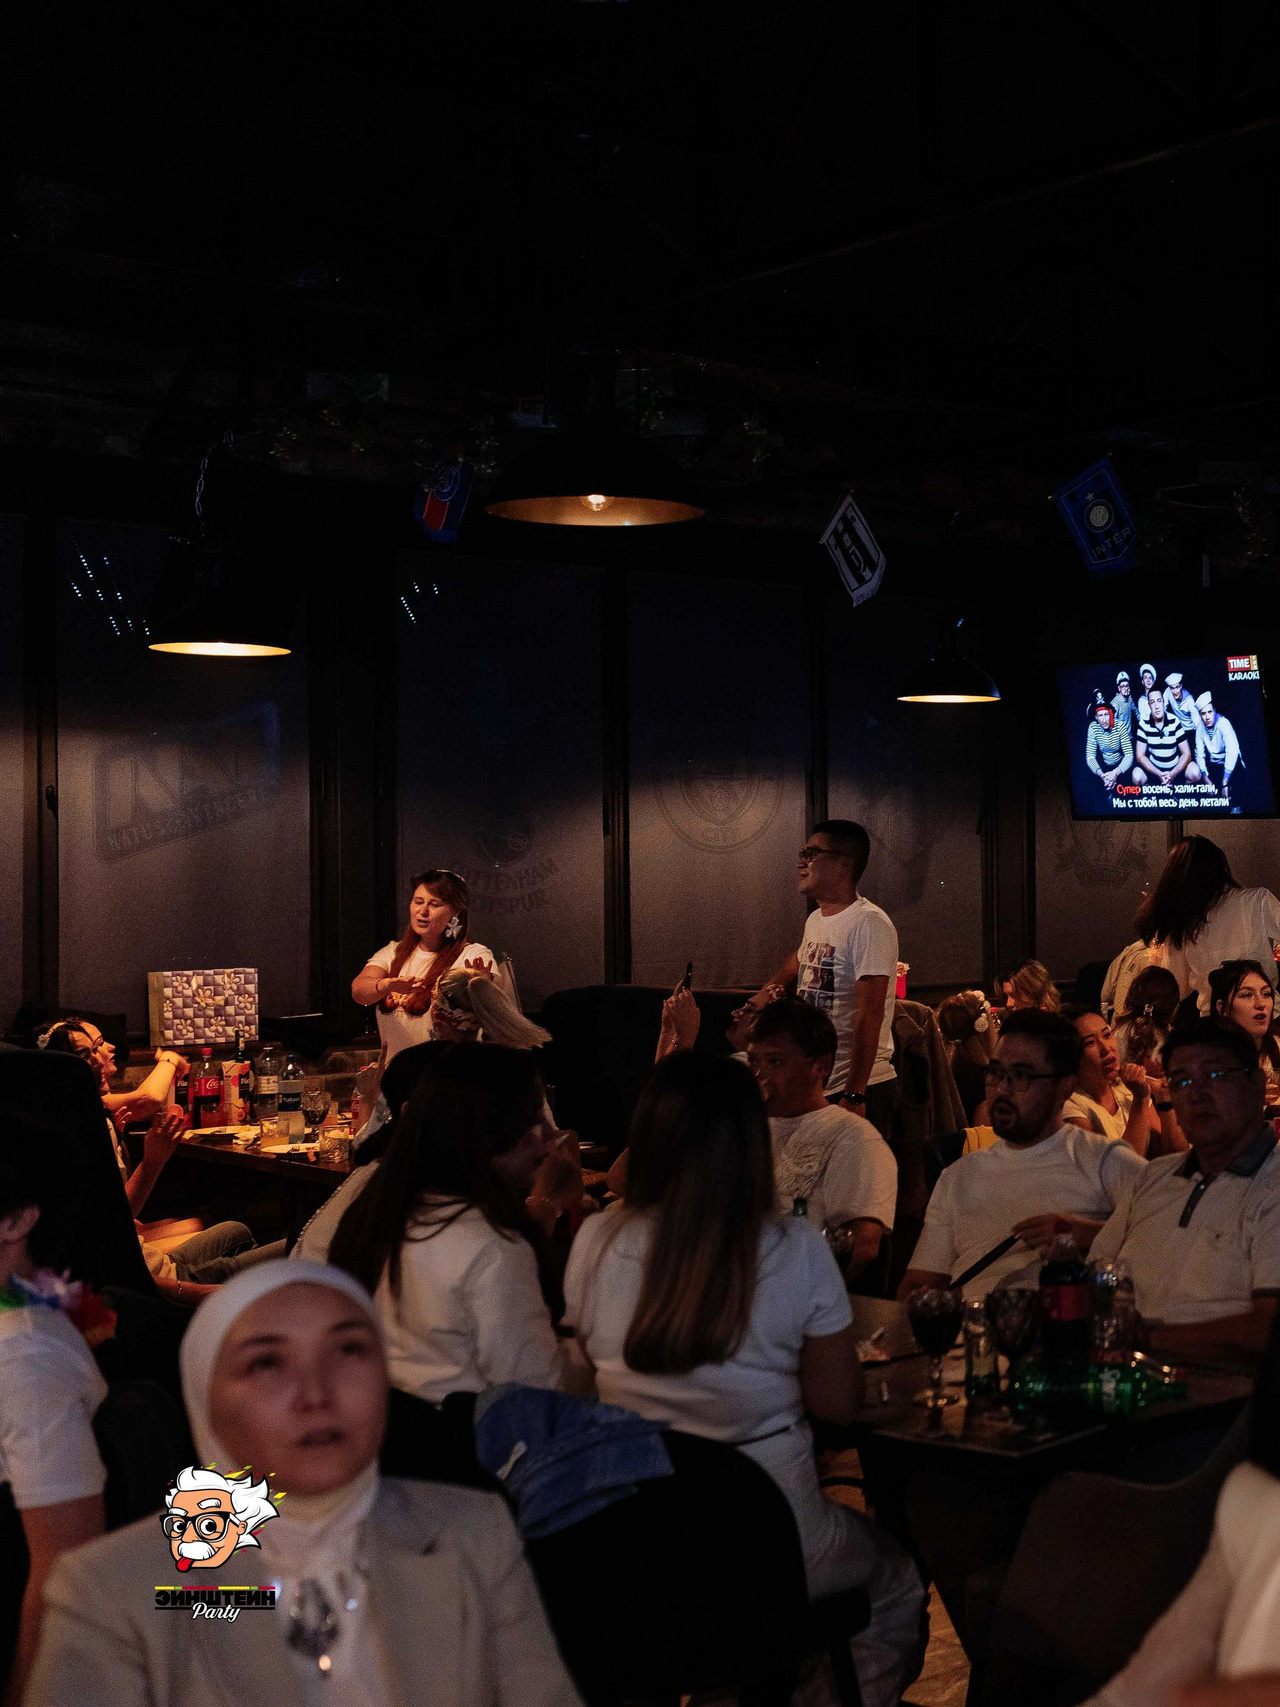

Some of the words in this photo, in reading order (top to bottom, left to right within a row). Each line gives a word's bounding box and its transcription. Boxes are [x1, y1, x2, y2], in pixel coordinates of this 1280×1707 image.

[1092, 526, 1132, 558] INTER
[1228, 658, 1250, 669] TIME
[1116, 784, 1141, 796] Супер
[1142, 784, 1173, 796] восемь,
[1174, 784, 1219, 795] хали-гали,
[1112, 797, 1126, 808] Мы
[1127, 800, 1133, 808] с
[1133, 796, 1158, 808] тобой
[1159, 799, 1178, 808] весь
[1178, 798, 1199, 809] день
[1200, 797, 1230, 808] летали
